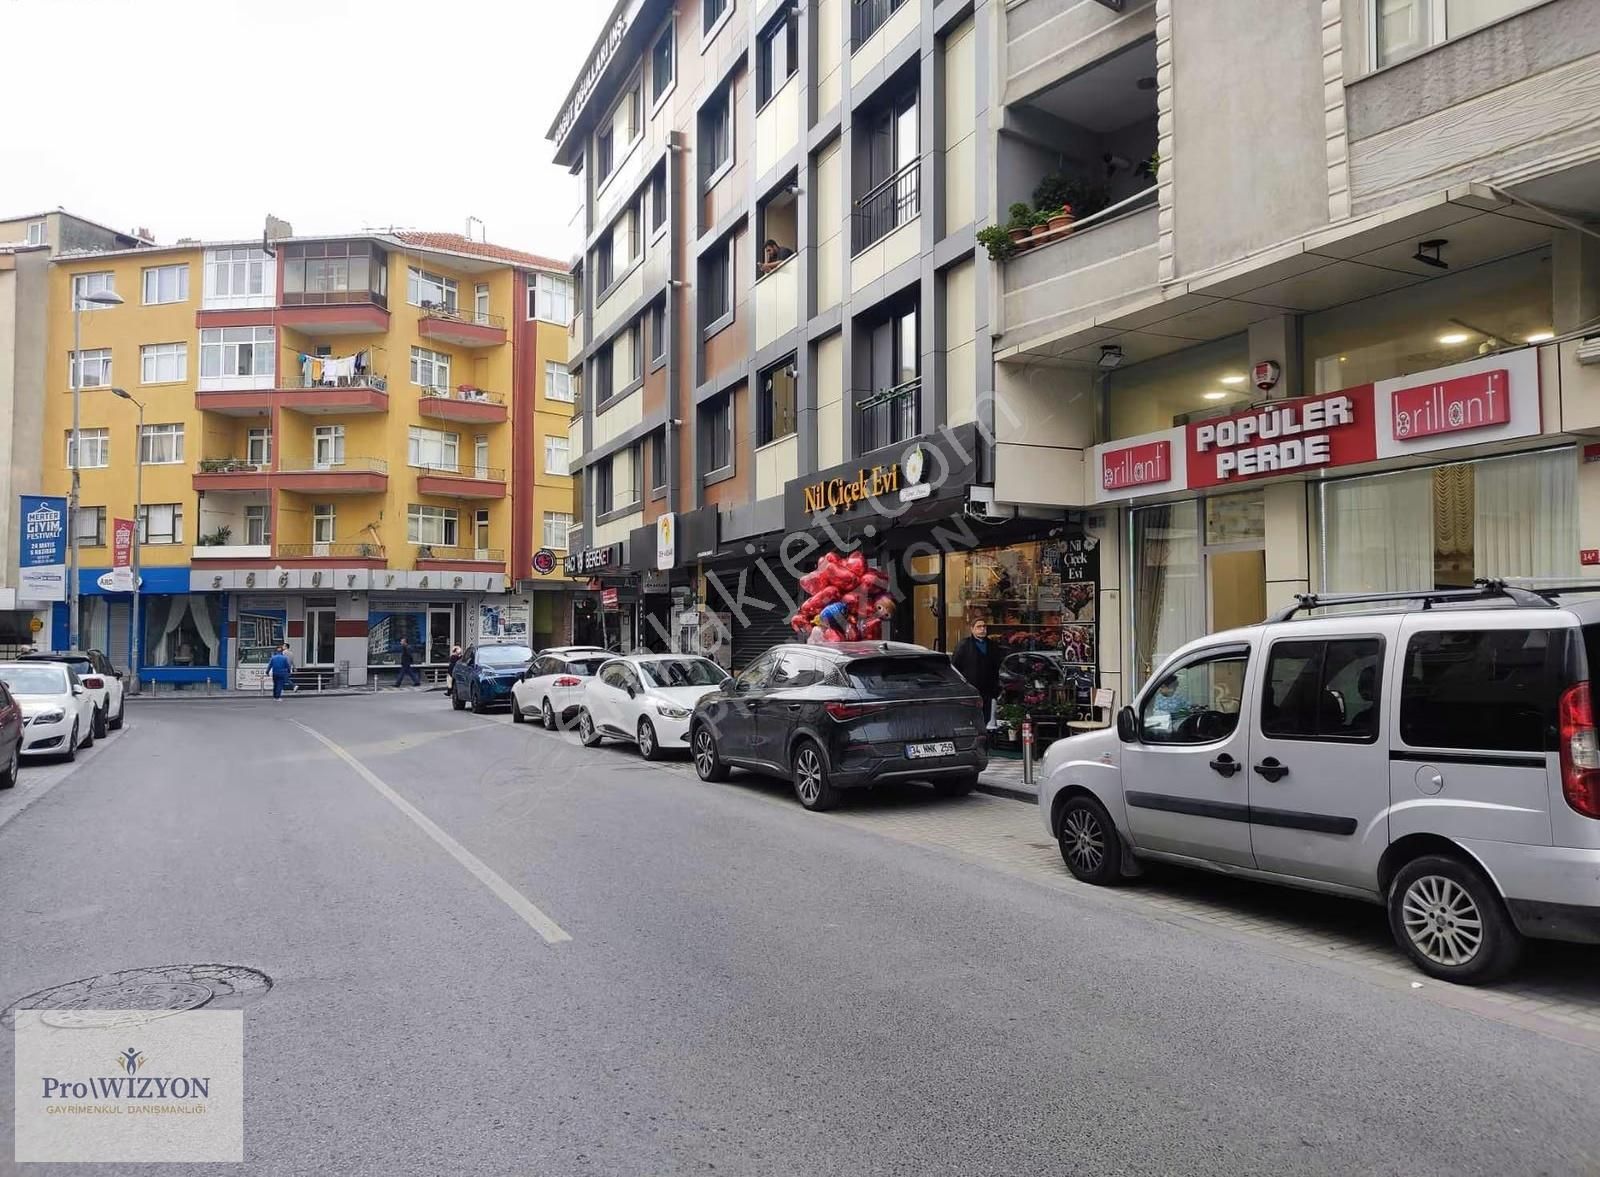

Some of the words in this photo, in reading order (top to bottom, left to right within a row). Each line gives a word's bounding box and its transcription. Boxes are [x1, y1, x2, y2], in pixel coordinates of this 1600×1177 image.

[1196, 395, 1352, 452] POPÜLER
[1395, 375, 1496, 436] brillant
[1104, 443, 1162, 486] brillant
[1216, 434, 1330, 479] PERDE
[804, 480, 825, 513] Nil
[827, 468, 869, 515] Çiçek
[871, 463, 898, 496] Evi
